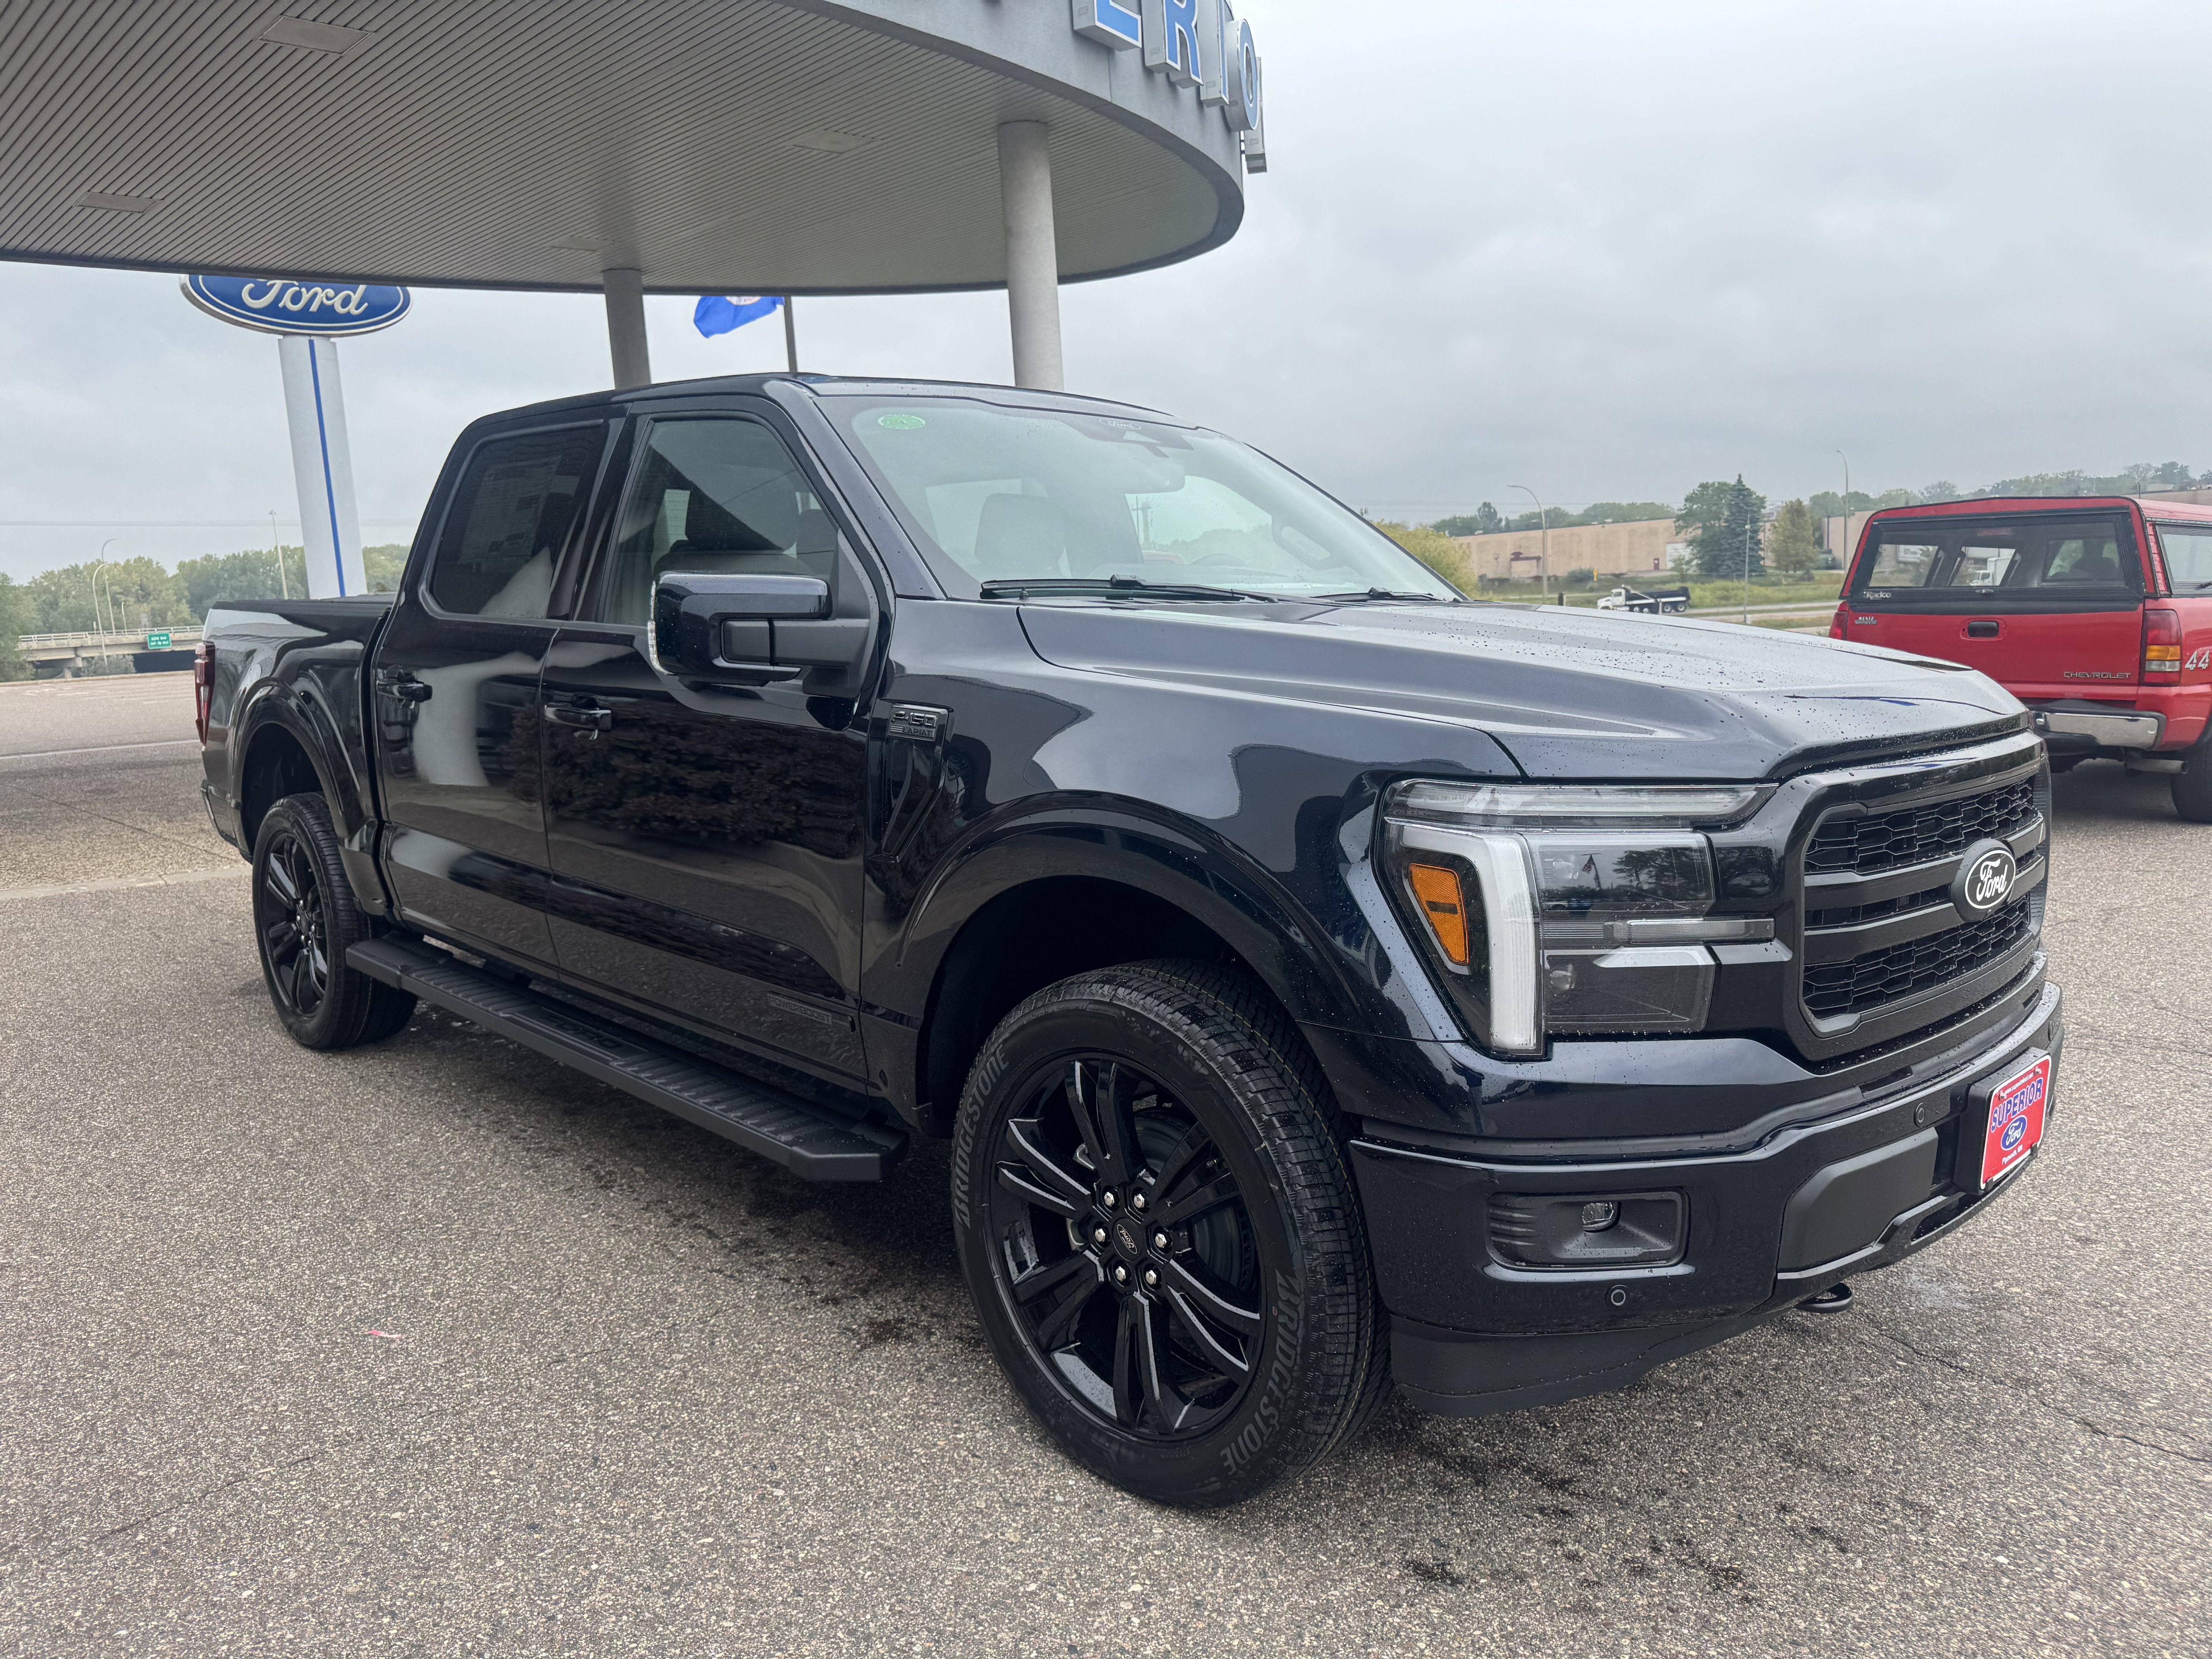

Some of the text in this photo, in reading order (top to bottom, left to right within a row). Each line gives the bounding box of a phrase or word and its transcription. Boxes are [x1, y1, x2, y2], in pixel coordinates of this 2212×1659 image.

[892, 711, 937, 727] F-150
[903, 727, 933, 737] LARIAT
[1976, 859, 2008, 902] Ford
[769, 994, 830, 1024] POWERBOOST
[1990, 1077, 2043, 1133] SUPERIOR
[954, 1043, 1009, 1229] BRIDGESTONE
[2006, 1121, 2023, 1146] Ford
[1119, 1228, 1135, 1249] Ford
[1220, 1267, 1302, 1475] BRIDGESTONE
